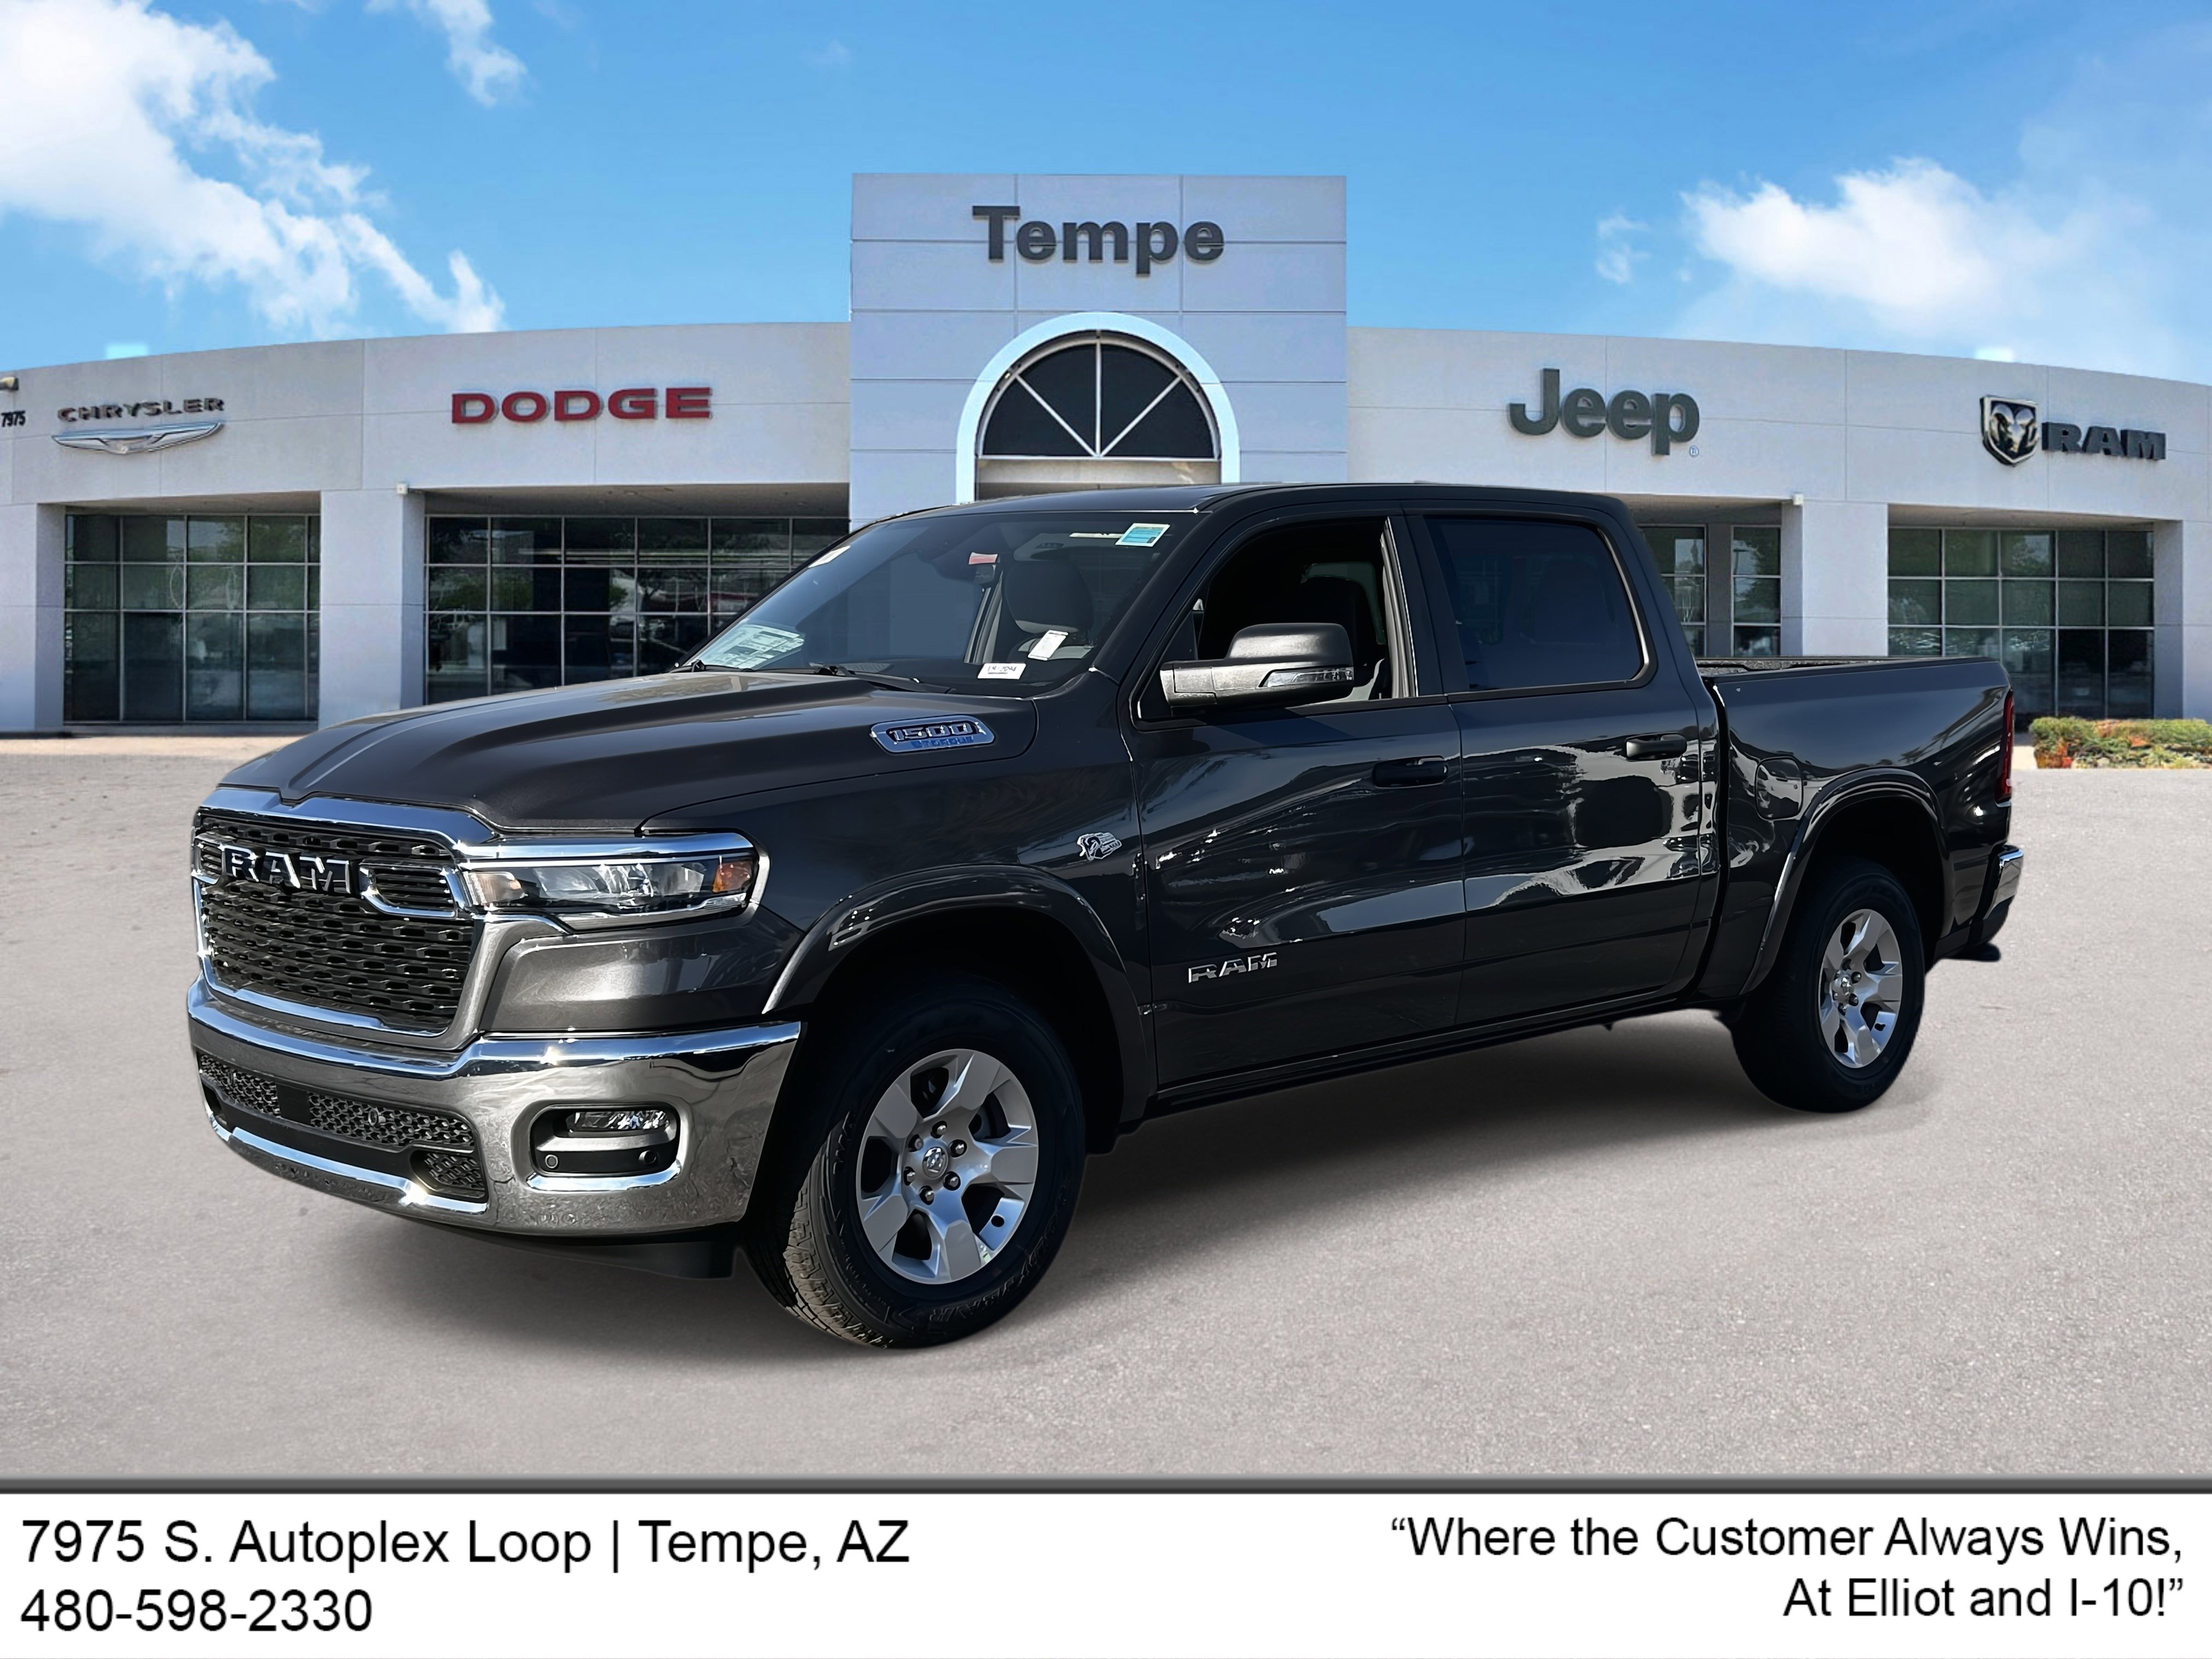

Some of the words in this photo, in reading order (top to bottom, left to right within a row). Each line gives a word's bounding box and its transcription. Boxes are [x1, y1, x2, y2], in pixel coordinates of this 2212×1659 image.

[972, 205, 1224, 277] Tempe
[1, 410, 26, 428] 7975
[57, 397, 225, 422] CHRYSLER
[452, 387, 712, 424] DODGE
[1508, 368, 1700, 456] Jeep
[2042, 422, 2166, 461] RAM
[890, 722, 973, 741] 1500
[224, 844, 353, 895] RAM
[1188, 952, 1278, 984] RAM
